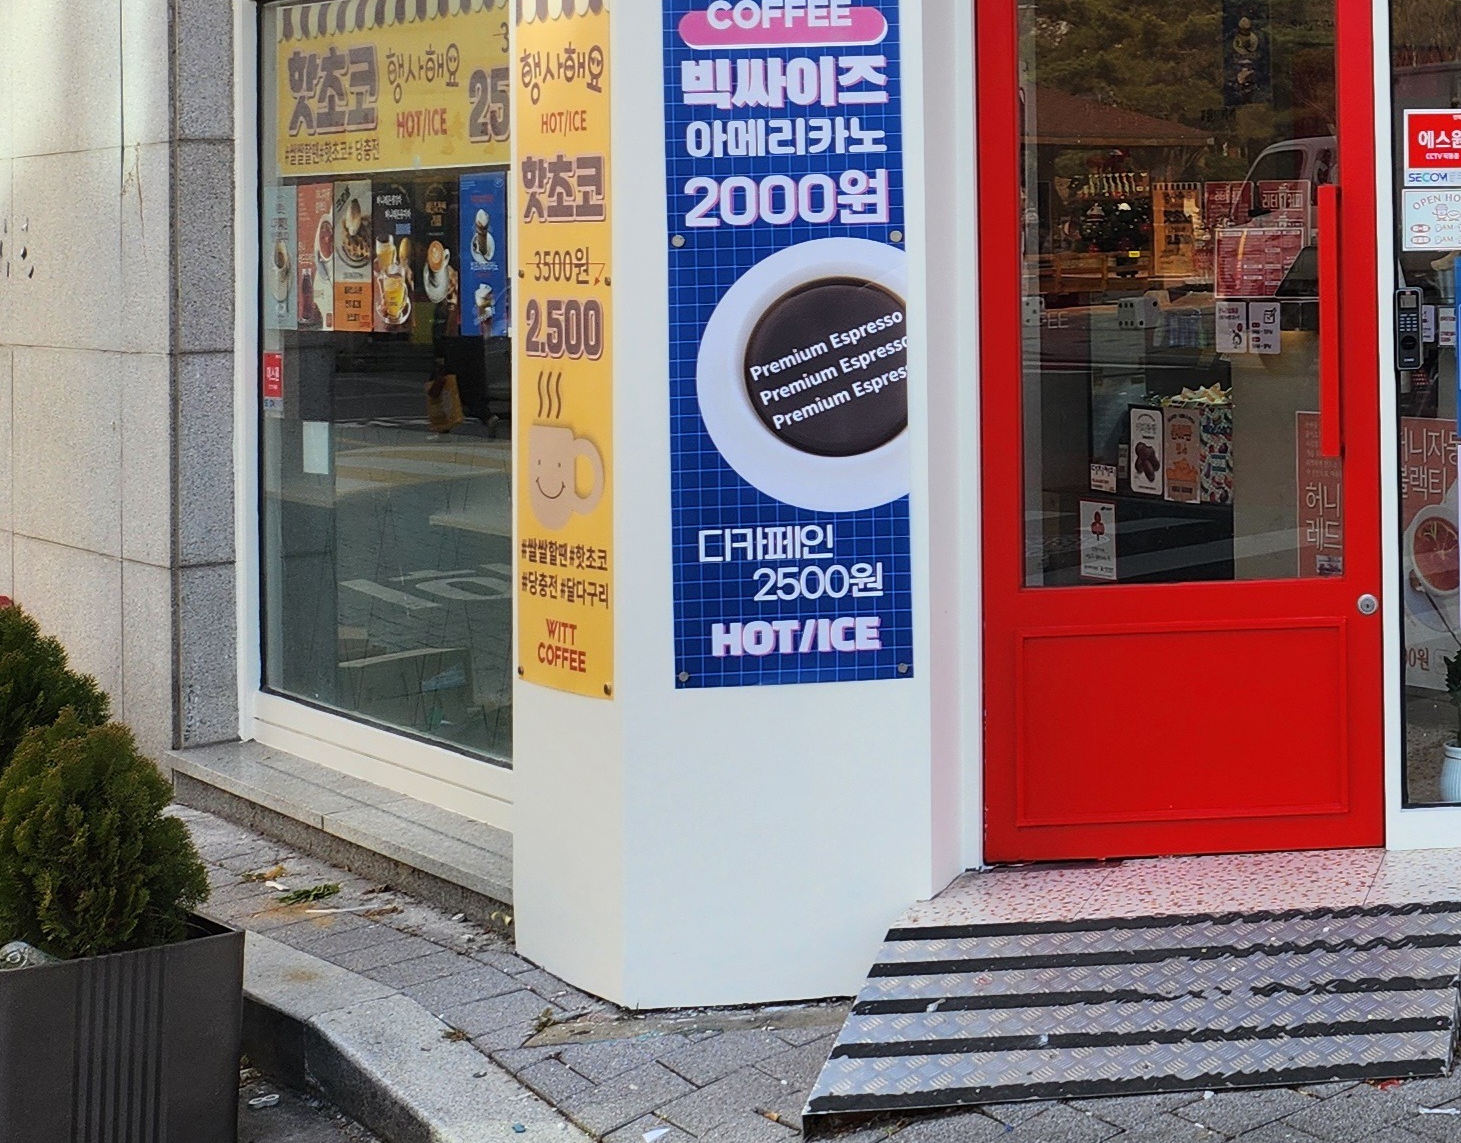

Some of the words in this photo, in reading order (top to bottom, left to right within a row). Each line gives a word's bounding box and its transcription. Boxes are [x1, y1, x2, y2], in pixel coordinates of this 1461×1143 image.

[288, 43, 380, 137] 핫초코
[386, 42, 460, 105] 행사해요
[520, 42, 605, 106] 행사해요
[681, 54, 889, 110] 빅싸이즈
[396, 108, 448, 141] HOT/ICE
[541, 108, 587, 138] HOT/ICE
[686, 117, 888, 158] 아메리카노
[521, 154, 606, 224] 핫초코
[683, 169, 890, 227] 2000원
[1408, 173, 1448, 183] SECOM
[1412, 194, 1441, 210] OPEN
[533, 246, 590, 286] 3500원
[749, 338, 828, 382] Premium
[829, 309, 903, 348] Espresso
[759, 364, 838, 406] Premium
[772, 391, 851, 430] Premium
[853, 361, 908, 398] Espres
[1304, 481, 1341, 518] 허니
[698, 524, 834, 562] 디카페인
[753, 561, 884, 602] 2500원
[545, 618, 577, 646] WITT
[711, 615, 882, 657] HOT/ICE
[537, 642, 586, 673] COFFEE
